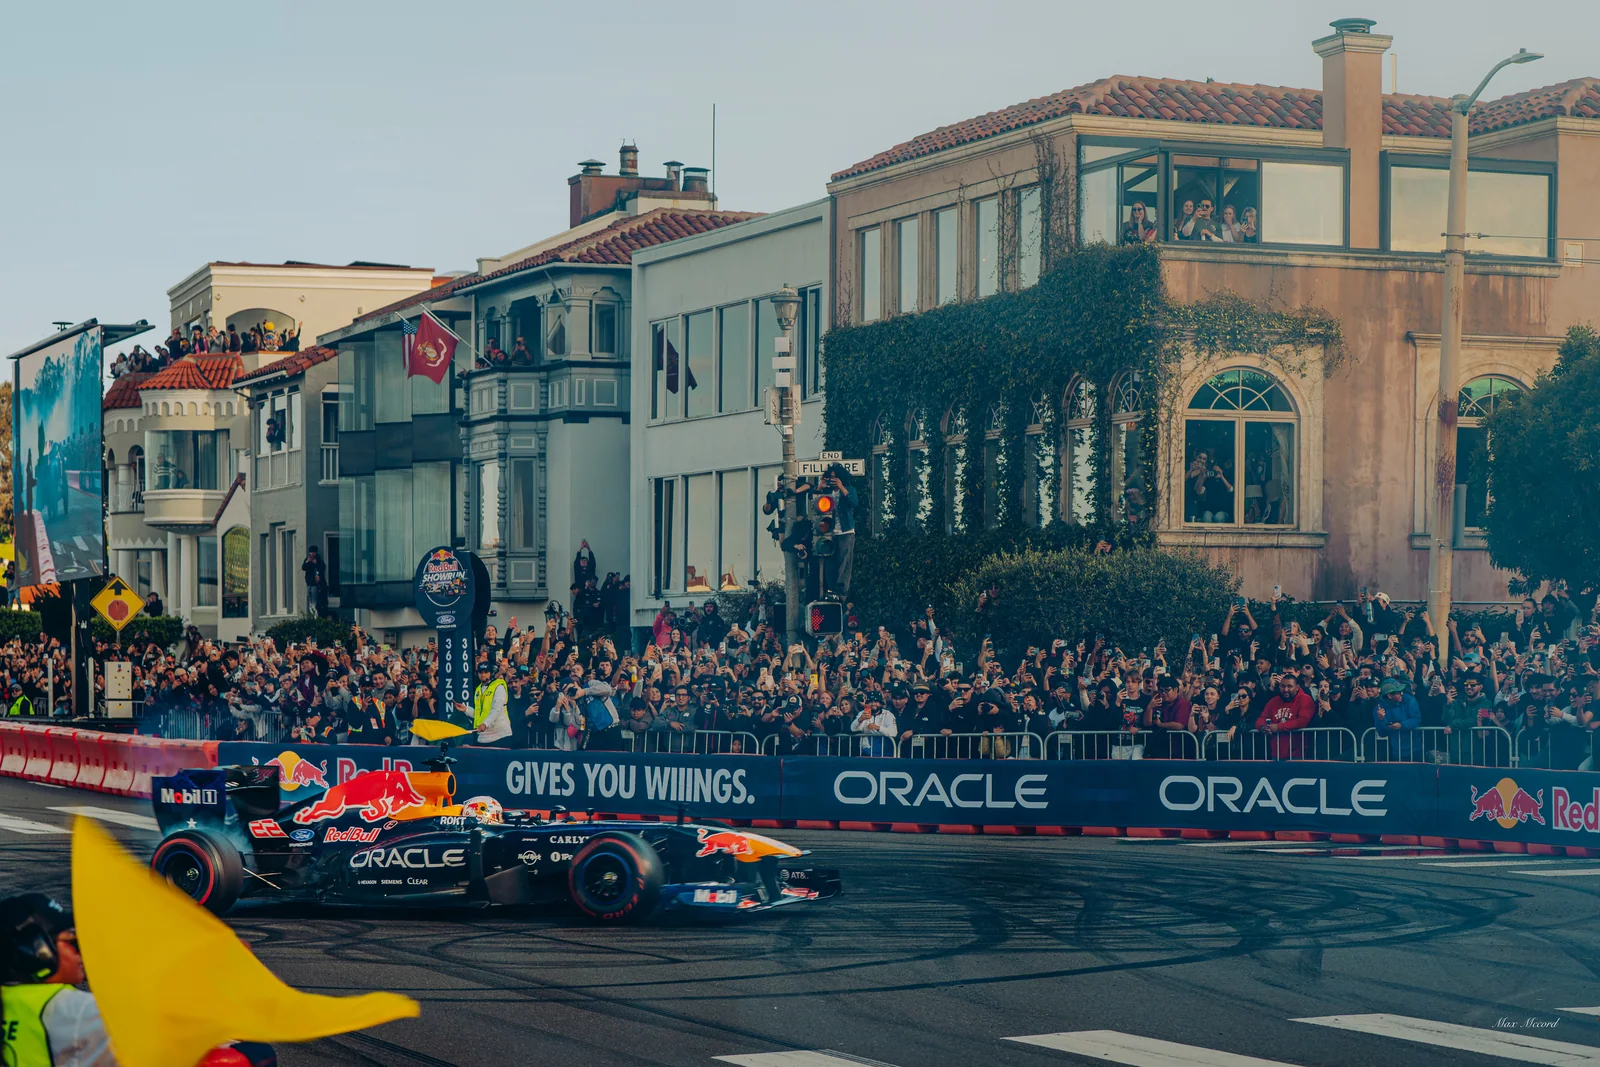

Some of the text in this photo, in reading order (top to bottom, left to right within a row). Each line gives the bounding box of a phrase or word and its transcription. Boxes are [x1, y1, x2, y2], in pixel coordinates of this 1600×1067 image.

[803, 463, 858, 473] FILLRE
[428, 560, 458, 573] Red Bull
[423, 571, 466, 582] SHOWRUN
[506, 760, 756, 804] GIVES YOU WIIINGS.
[833, 770, 1049, 810] ORACLE
[161, 788, 218, 805] Mobil 1
[1158, 775, 1388, 817] ORACLE
[1552, 786, 1600, 833] Red
[248, 818, 290, 839] 22
[439, 816, 467, 826] ROKT
[323, 827, 382, 843] Red Bull
[549, 835, 590, 844] CARLY
[350, 848, 467, 868] ORACLE
[790, 871, 809, 880] AT&
